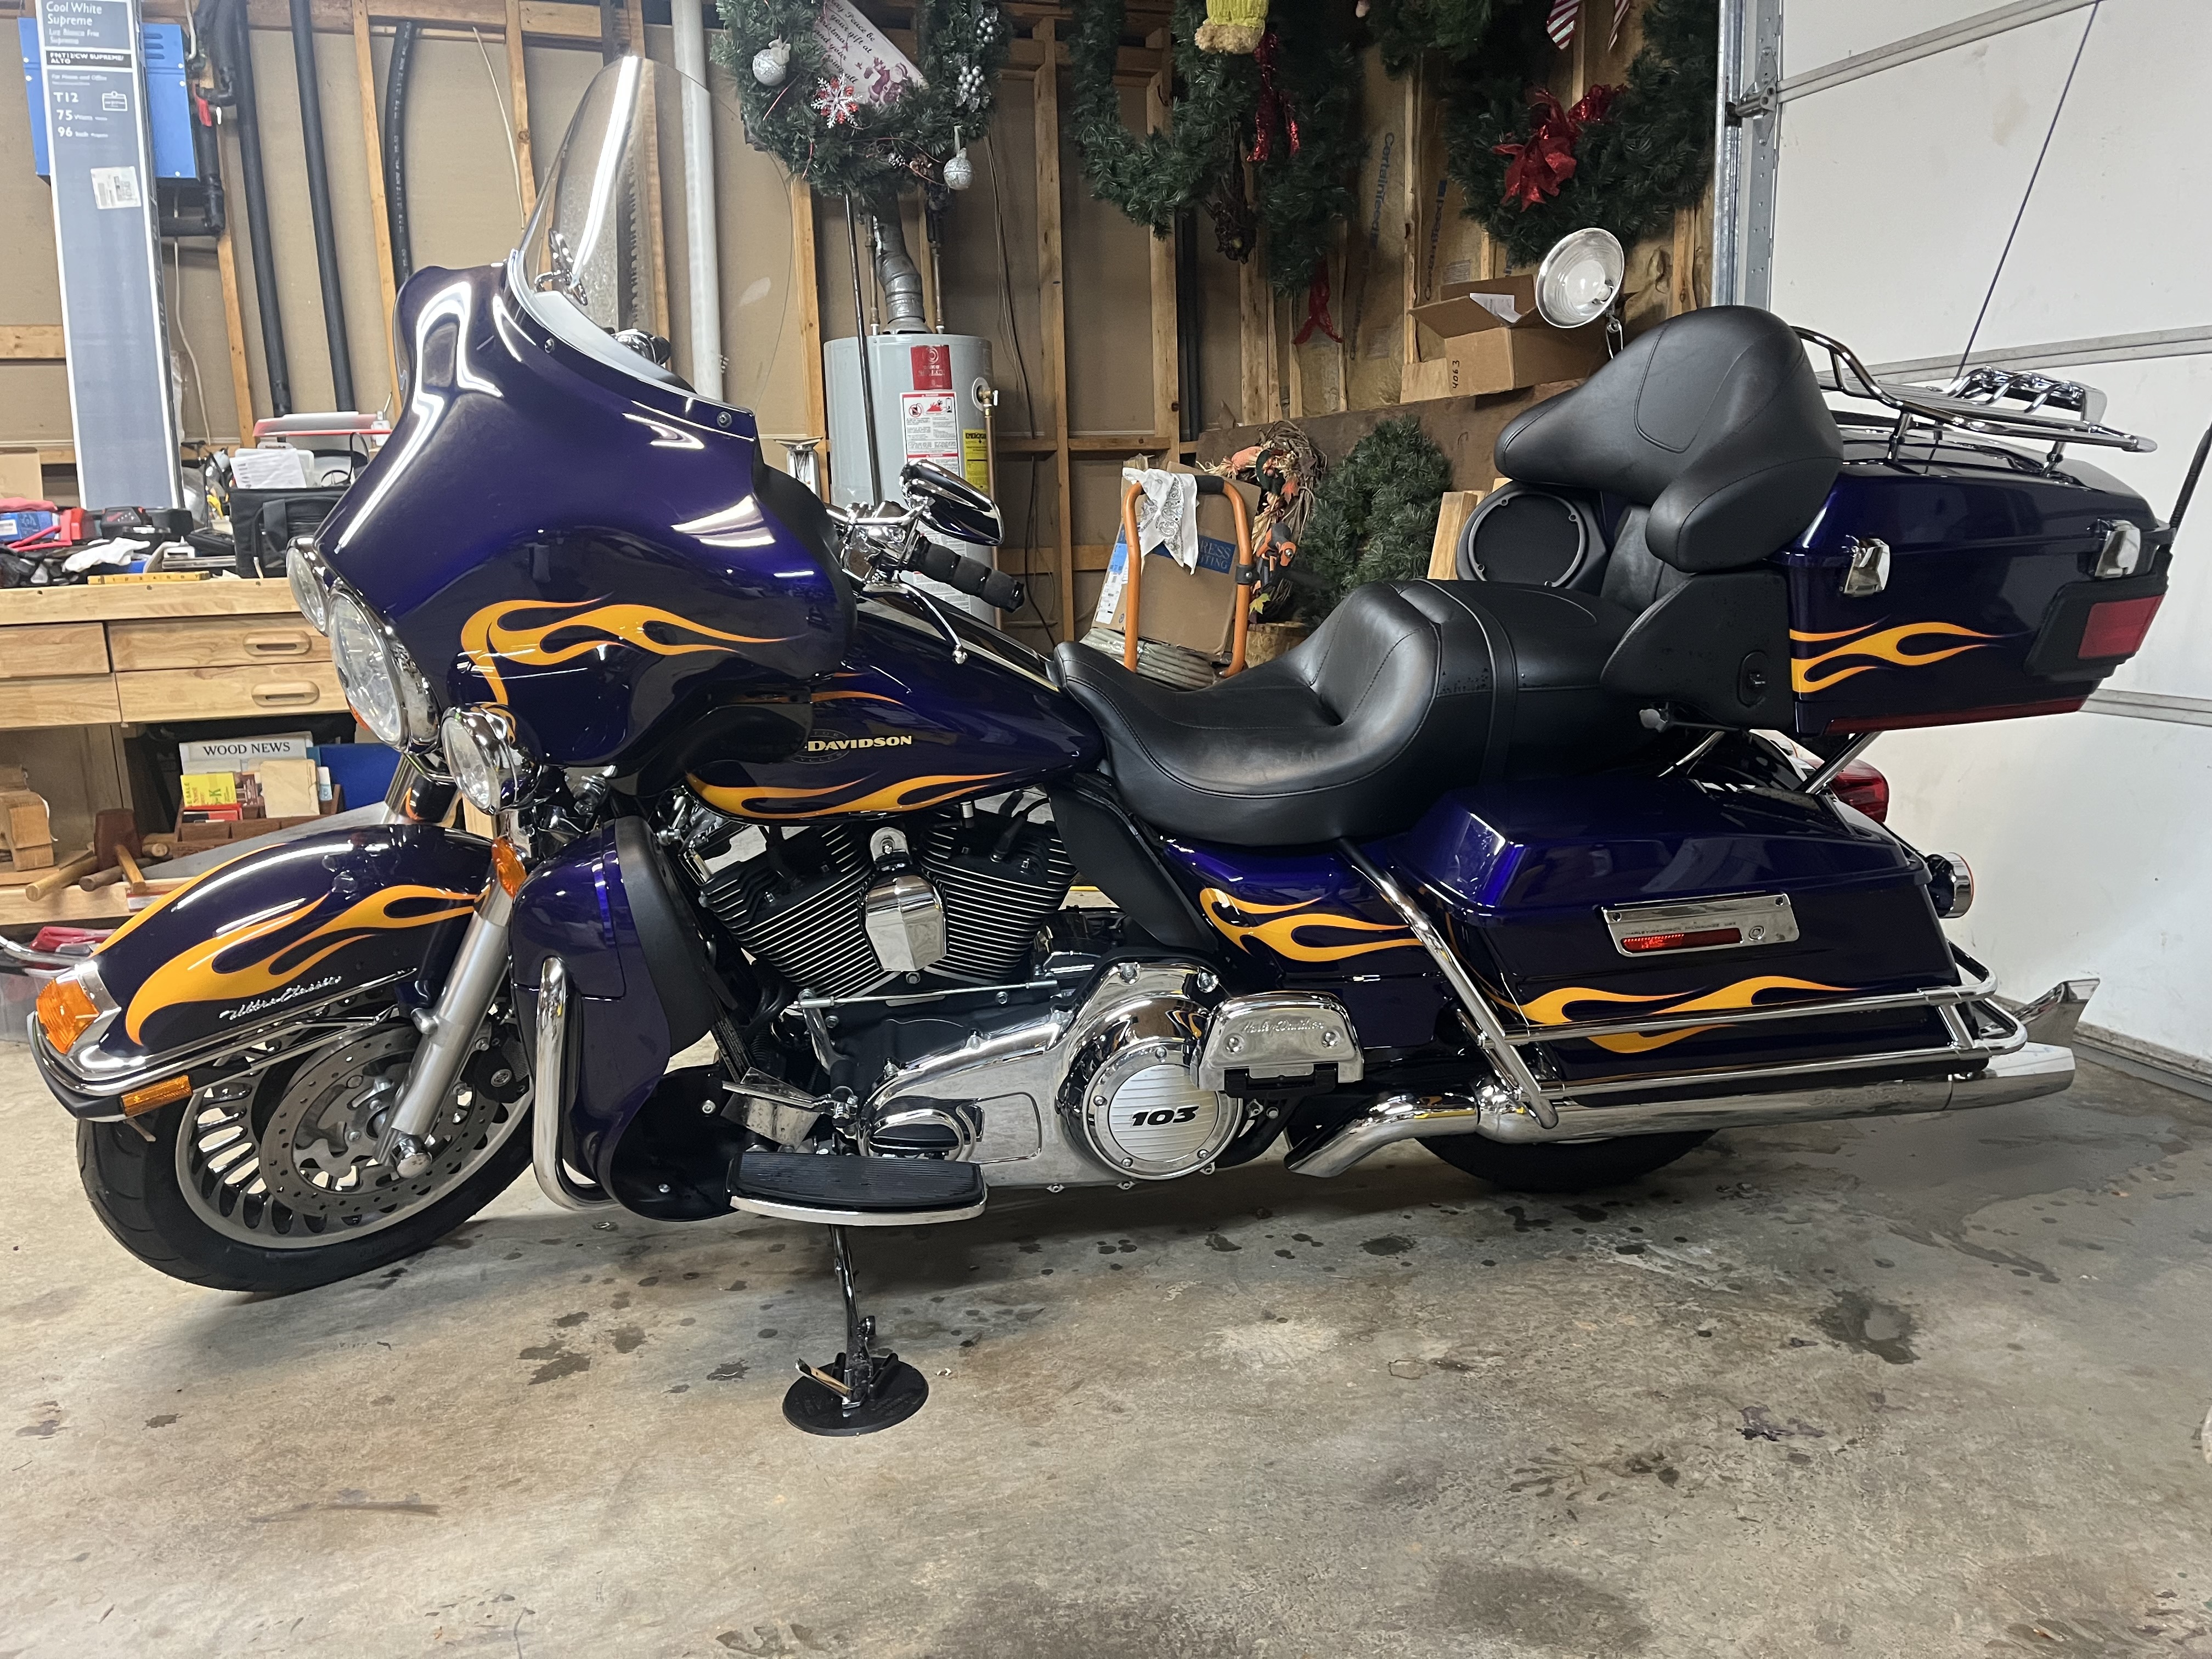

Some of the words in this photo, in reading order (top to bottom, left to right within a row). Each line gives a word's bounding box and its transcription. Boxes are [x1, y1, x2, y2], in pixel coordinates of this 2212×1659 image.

[46, 1, 69, 12] Cool
[71, 2, 102, 14] White
[48, 13, 93, 27] Supreme
[845, 12, 867, 34] Peace
[866, 32, 875, 42] be
[831, 14, 849, 32] your
[849, 31, 864, 46] gift
[862, 45, 872, 54] at
[53, 92, 79, 103] T12
[56, 109, 73, 121] 75
[58, 126, 73, 137] 96
[1200, 539, 1231, 559] RESS
[203, 744, 247, 756] WOOD
[251, 742, 290, 754] NEWS
[808, 736, 912, 752] DAVIDSON
[800, 752, 842, 762] YCLES
[1131, 1105, 1200, 1127] 103
